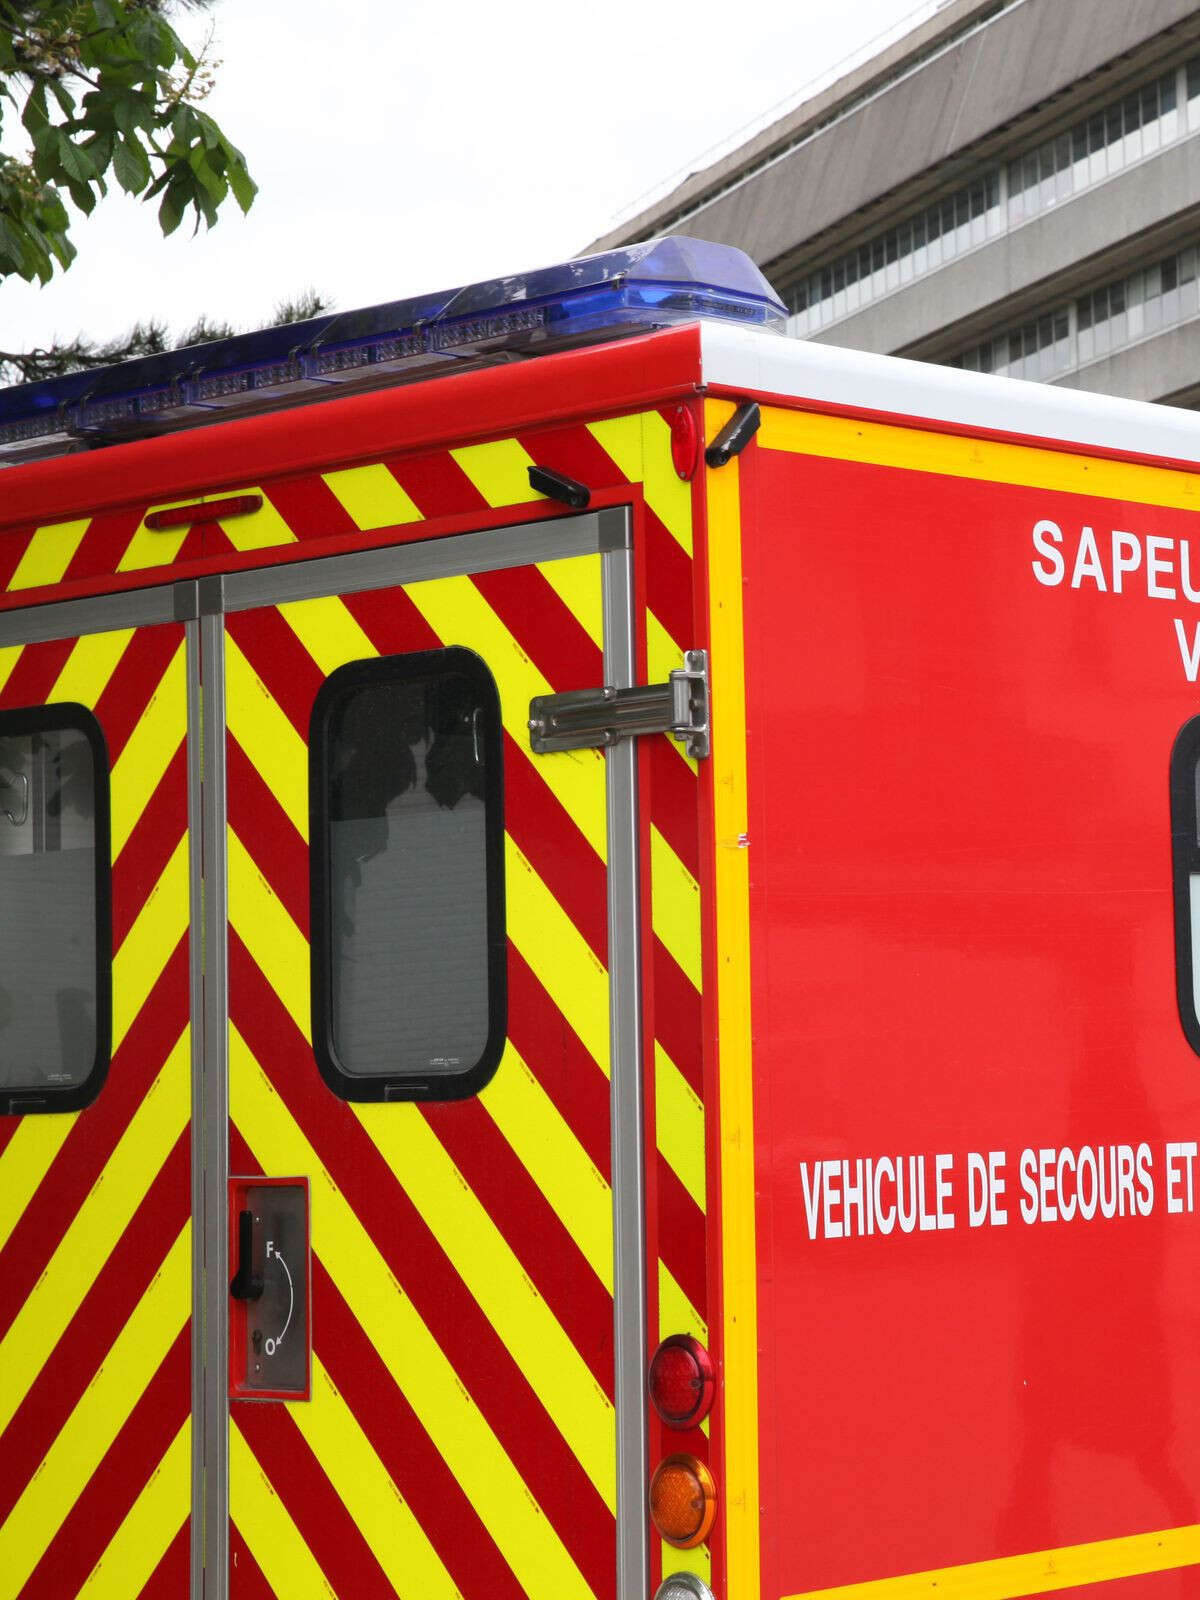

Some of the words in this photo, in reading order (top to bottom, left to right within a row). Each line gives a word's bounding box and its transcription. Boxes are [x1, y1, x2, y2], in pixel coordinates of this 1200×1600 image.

[799, 1153, 955, 1240] VEHICULE
[967, 1150, 1008, 1228] DE
[1019, 1142, 1154, 1225] SECOURS
[1165, 1141, 1198, 1214] ET
[266, 1241, 274, 1258] F
[265, 1338, 276, 1356] O
